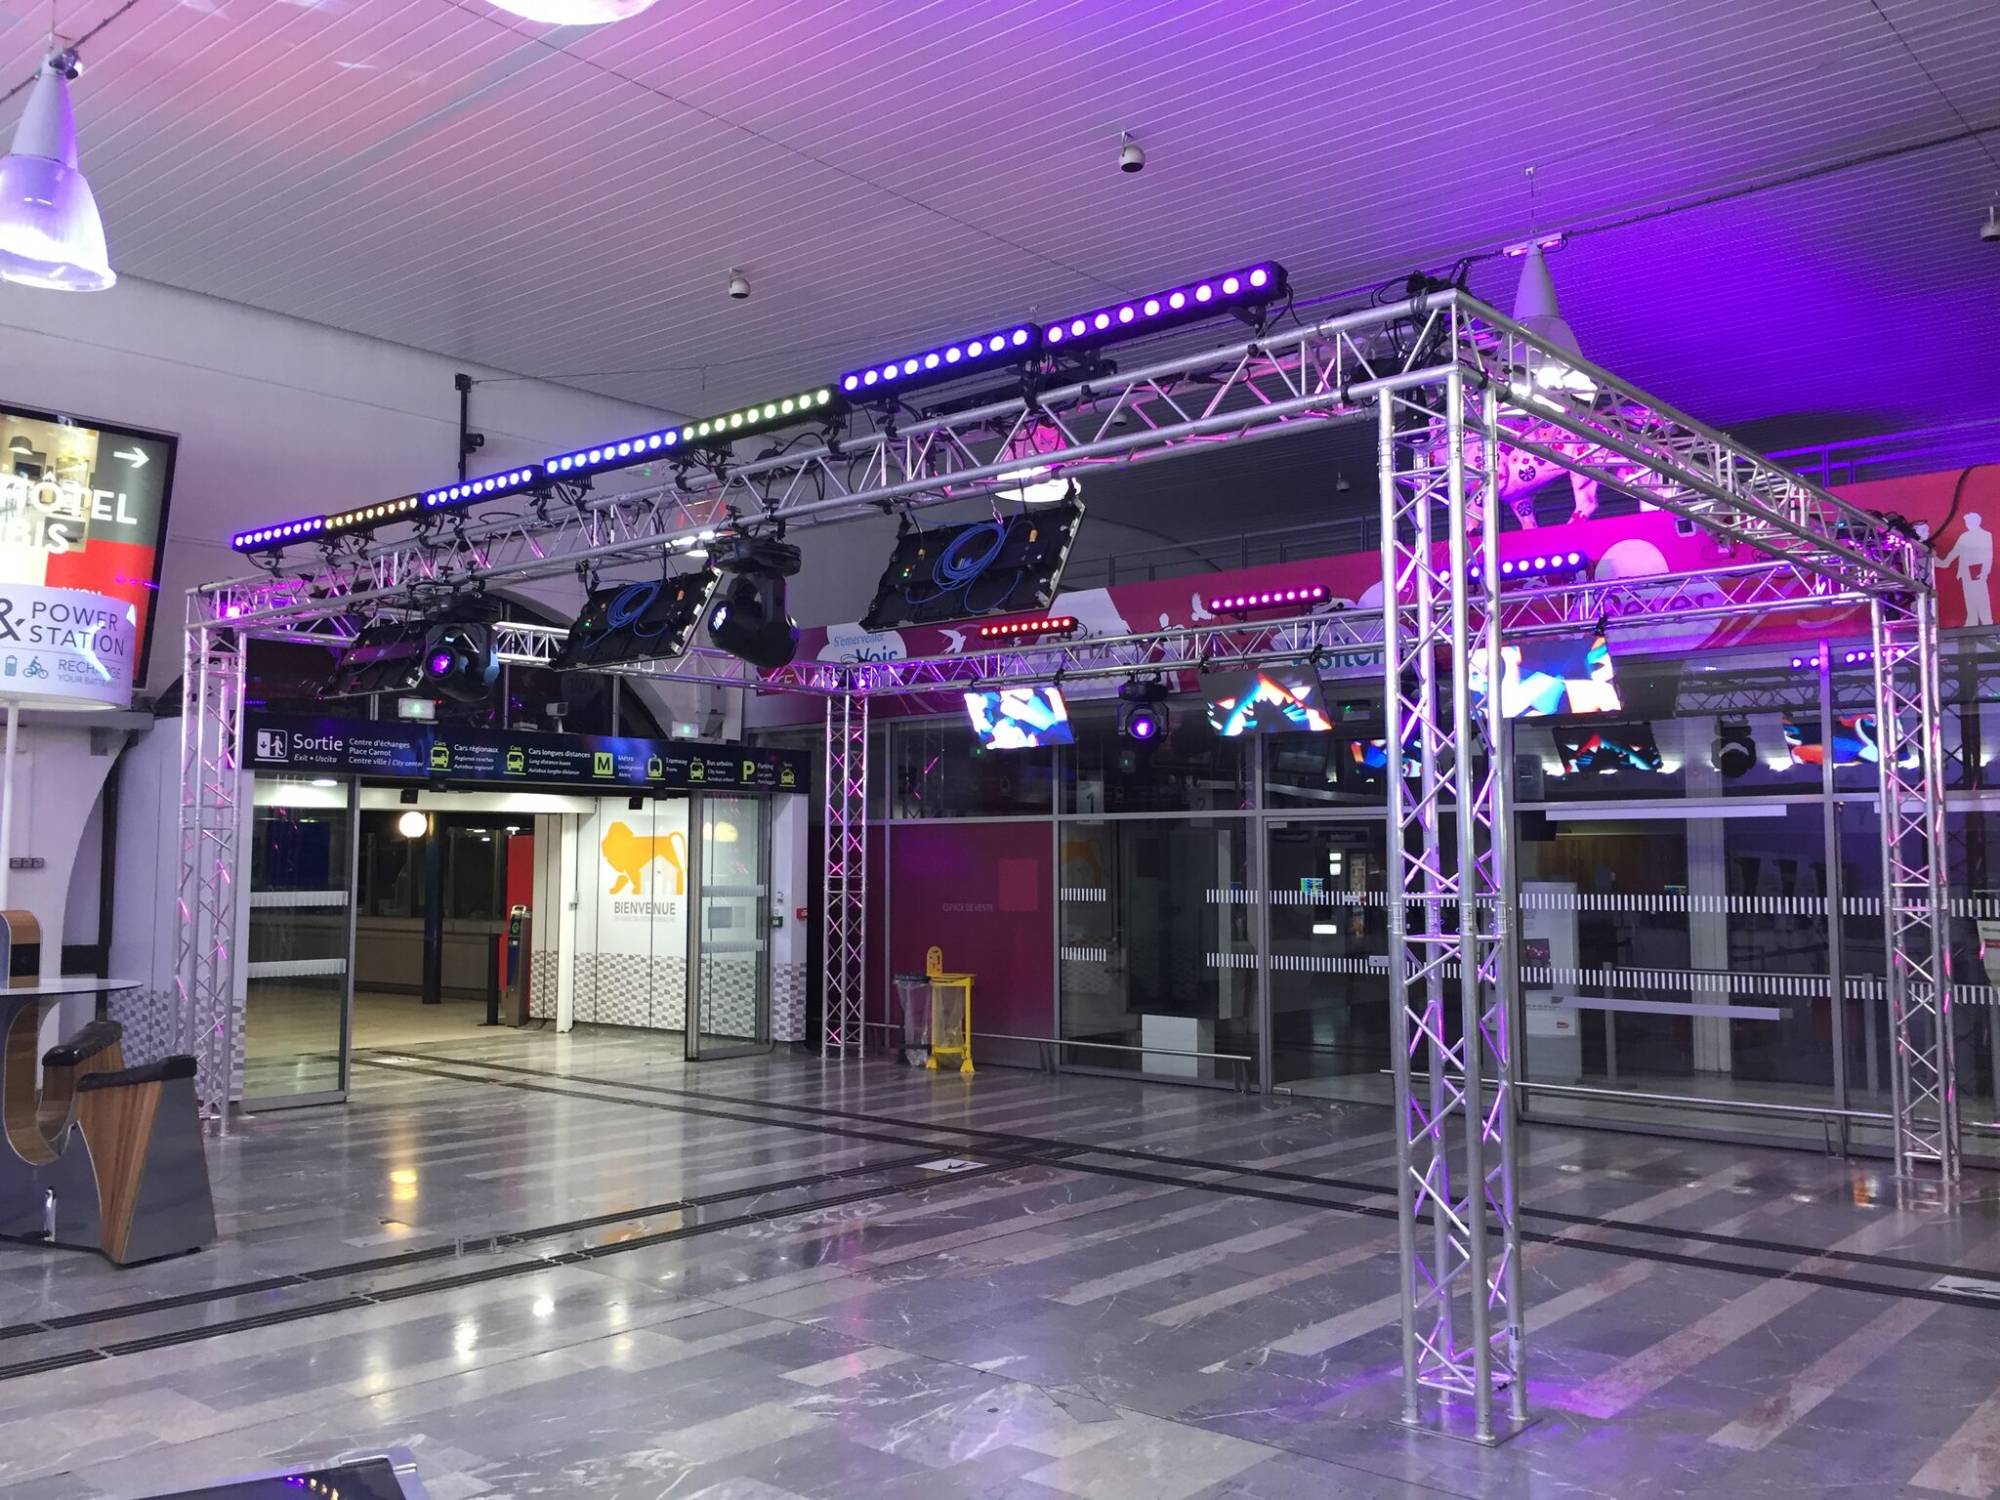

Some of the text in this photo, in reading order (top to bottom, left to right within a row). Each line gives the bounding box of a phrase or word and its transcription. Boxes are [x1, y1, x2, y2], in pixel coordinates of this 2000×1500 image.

[0, 598, 26, 642] &
[31, 601, 118, 632] POWER
[29, 625, 125, 657] STATION
[58, 659, 122, 680] RECHGE
[293, 733, 344, 751] Sortie
[348, 738, 410, 749] Centre d'échanges
[454, 744, 498, 754] Cars régionaux
[349, 747, 392, 757] Place Carnot
[542, 749, 564, 758] longues
[348, 756, 372, 765] Centre
[373, 758, 387, 766] ville
[392, 759, 404, 767] City
[597, 757, 610, 771] M
[743, 761, 755, 781] P
[614, 901, 676, 915] BIENVENUE
